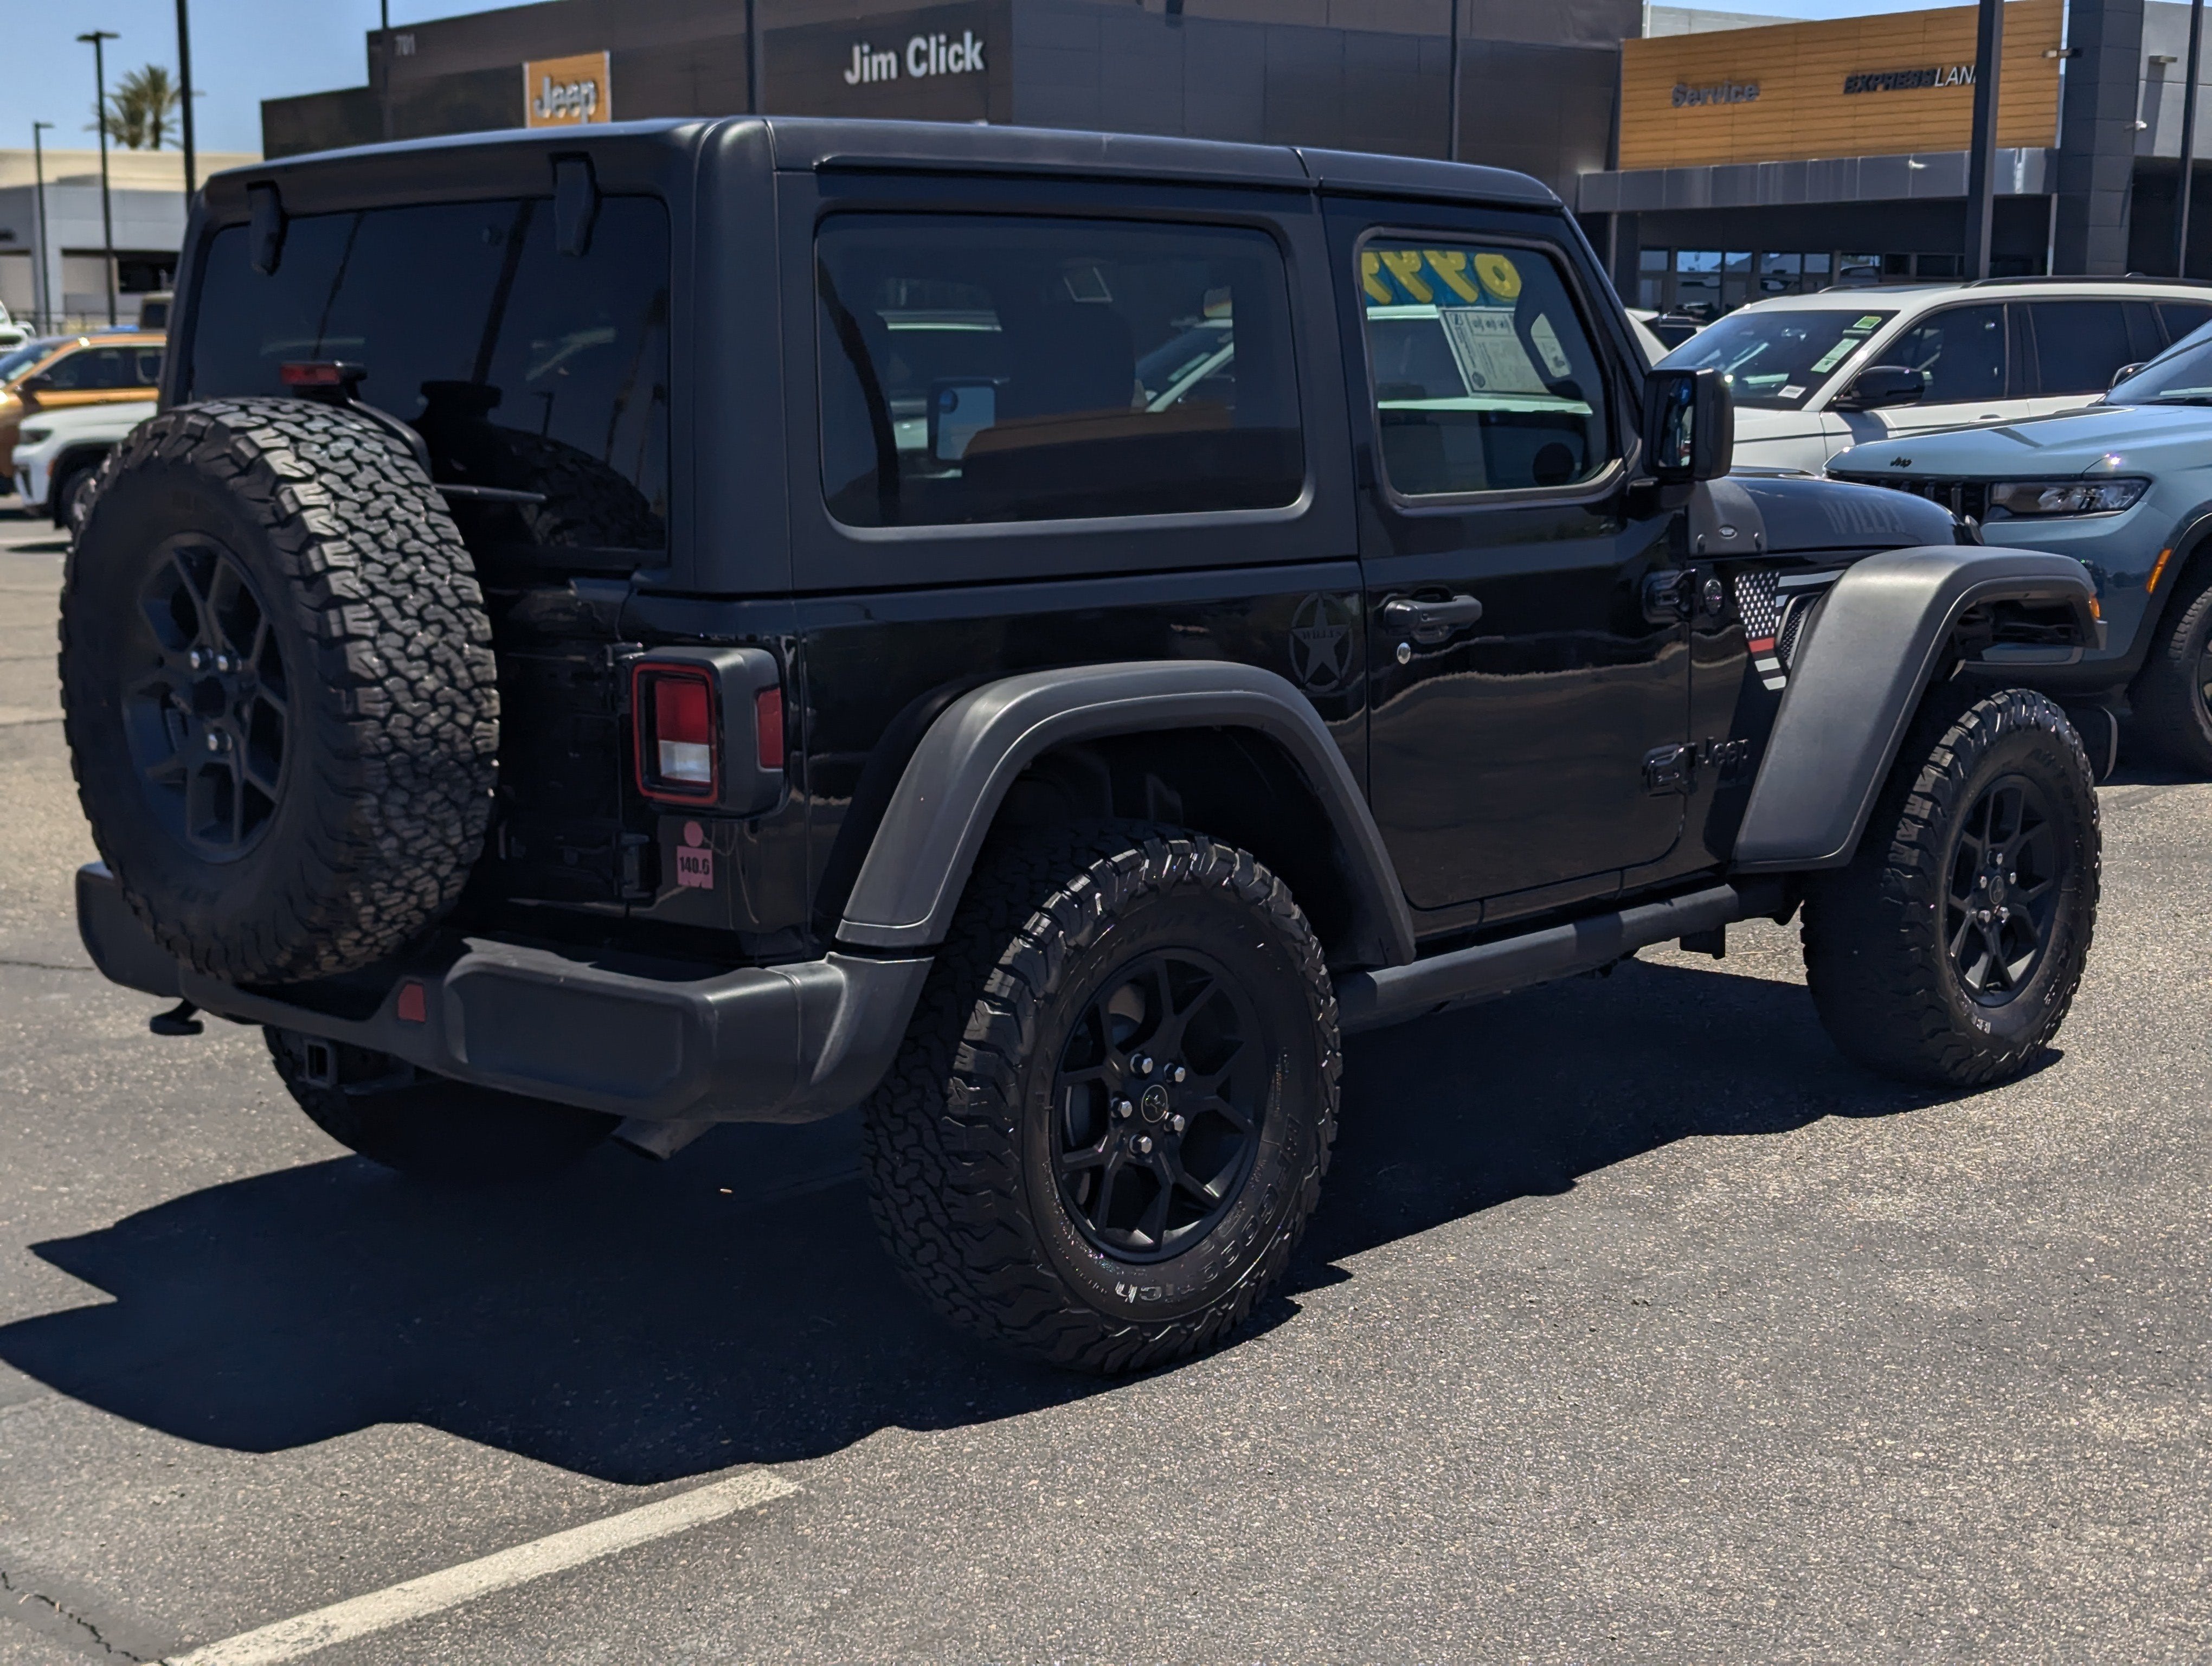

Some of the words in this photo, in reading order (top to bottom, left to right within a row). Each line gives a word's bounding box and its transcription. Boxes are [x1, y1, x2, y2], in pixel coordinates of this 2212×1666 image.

[844, 43, 898, 85] Jim
[906, 30, 985, 78] Click
[1672, 80, 1760, 108] Service
[1844, 65, 1976, 94] EXPRESSLAN
[533, 75, 596, 124] Jeep
[680, 856, 710, 875] 140.6
